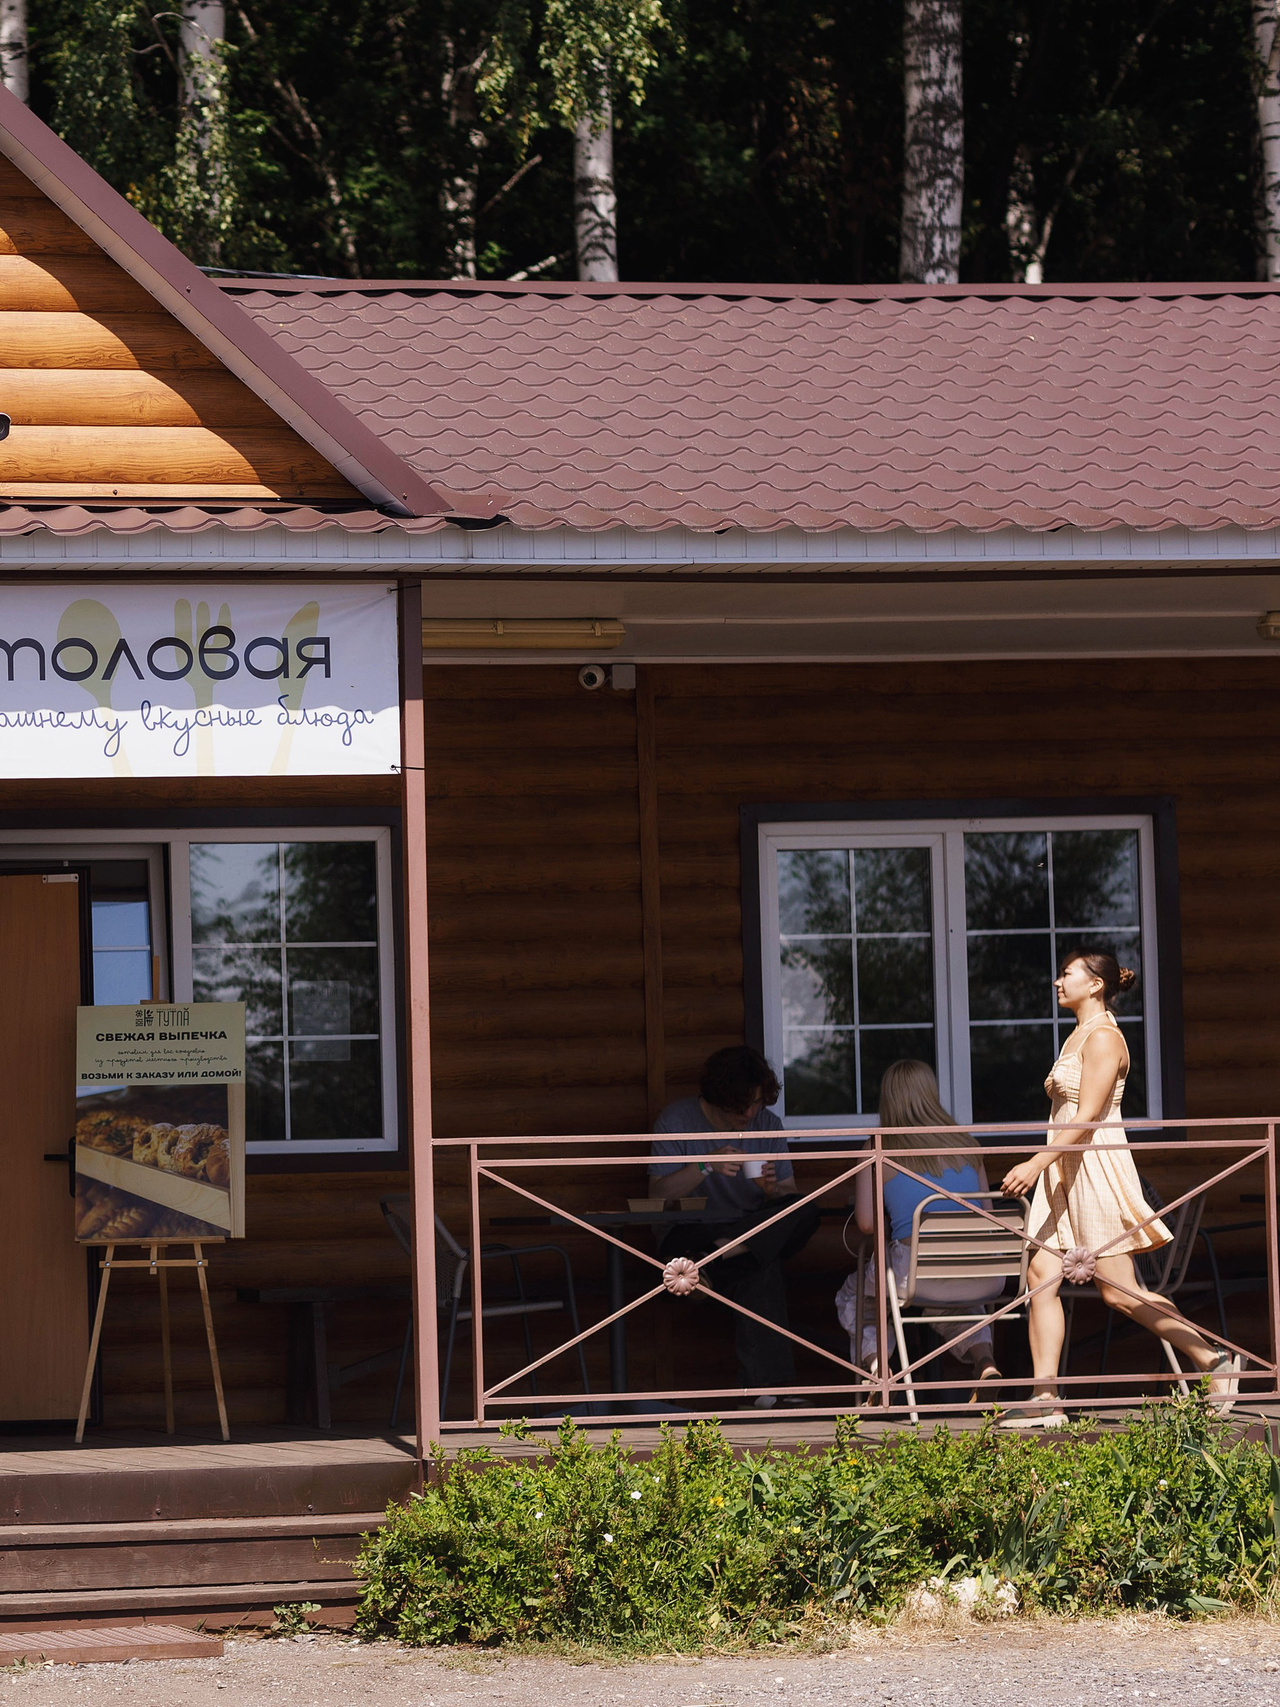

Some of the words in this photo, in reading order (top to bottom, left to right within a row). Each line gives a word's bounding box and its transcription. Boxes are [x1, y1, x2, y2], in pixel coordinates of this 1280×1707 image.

[140, 700, 263, 758] вкусные
[276, 694, 376, 747] блюда
[95, 1032, 155, 1042] СВЕЖАЯ
[159, 1030, 227, 1041] ВЫПЕЧКА
[81, 1072, 124, 1080] ВОЗЬМИ
[135, 1071, 174, 1079] ЗАКАЗУ
[201, 1068, 242, 1078] ДОМОЙ!
